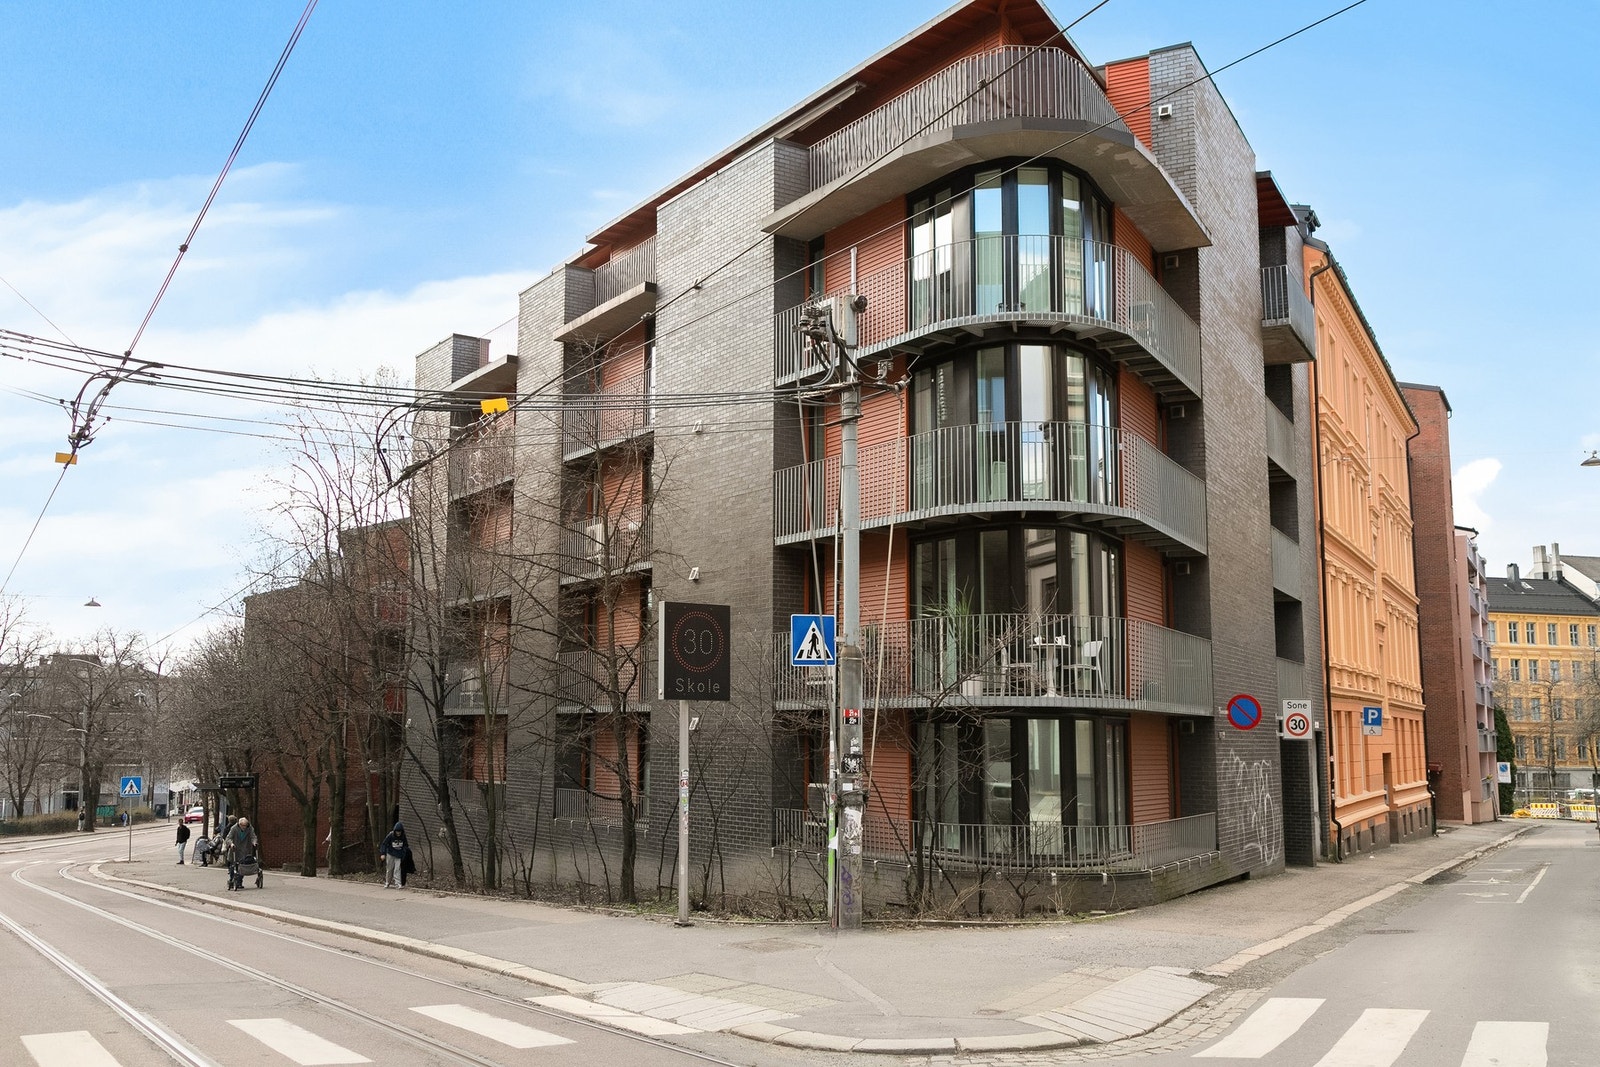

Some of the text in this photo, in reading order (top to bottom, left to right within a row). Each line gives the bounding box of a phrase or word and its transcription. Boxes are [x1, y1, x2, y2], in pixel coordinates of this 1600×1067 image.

[684, 629, 712, 655] 30
[675, 677, 720, 693] Skole
[1287, 701, 1307, 709] Sone
[1368, 709, 1378, 724] P
[1290, 719, 1305, 730] 30
